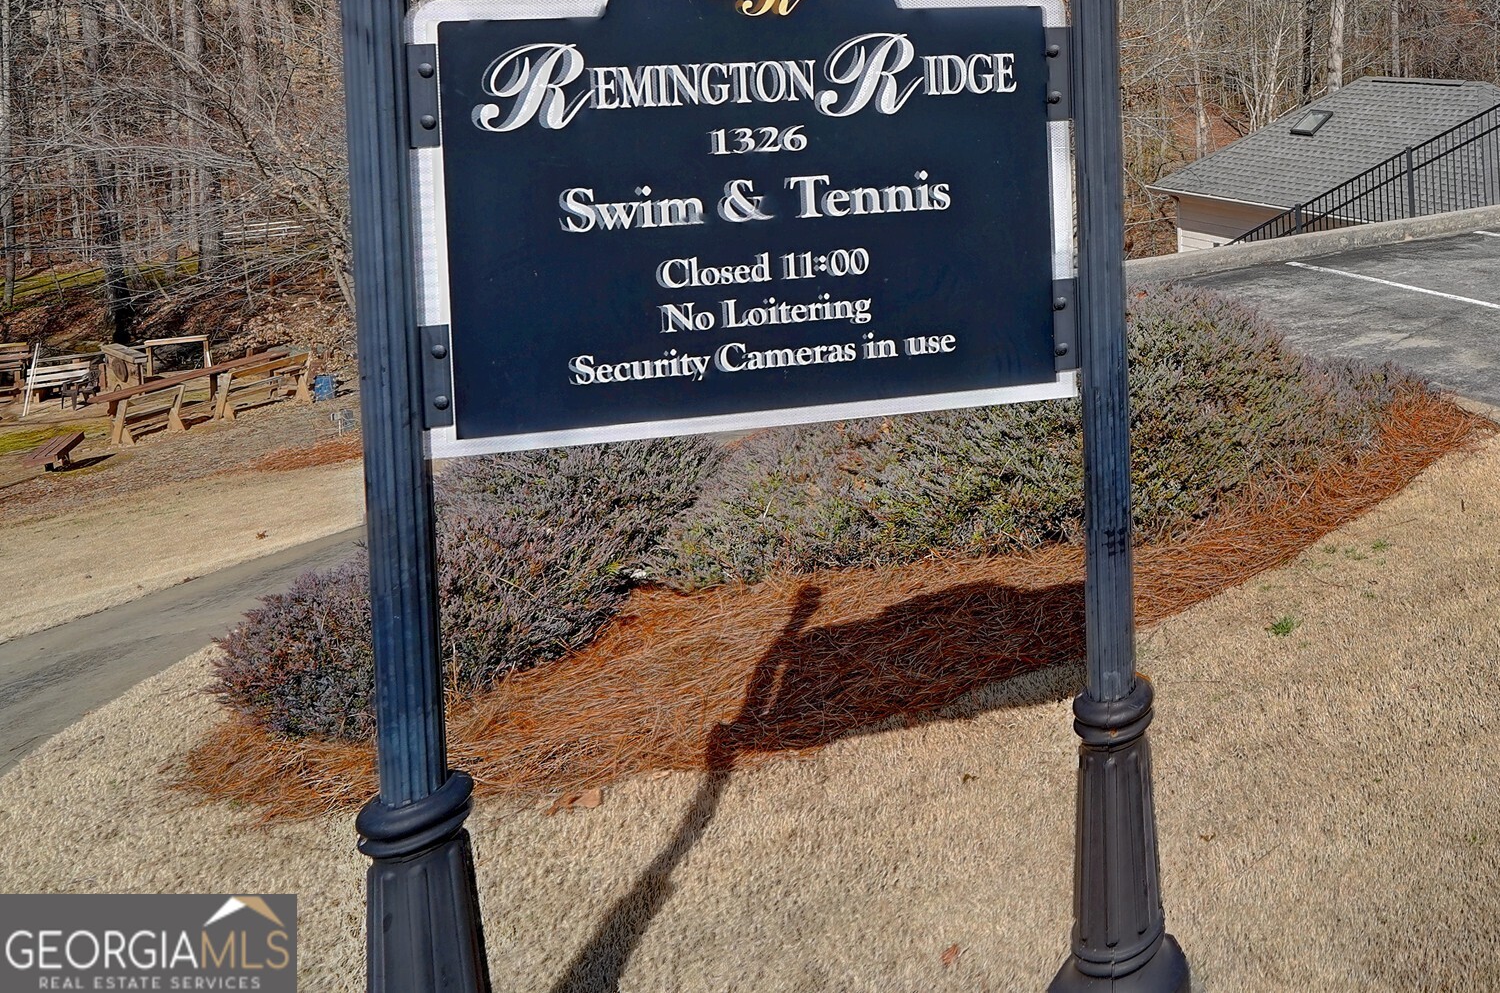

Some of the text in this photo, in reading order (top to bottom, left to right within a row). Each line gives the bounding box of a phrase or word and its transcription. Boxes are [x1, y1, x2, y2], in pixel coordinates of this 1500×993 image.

[474, 32, 1018, 132] REMINGTON RIDGE
[708, 125, 808, 155] 1326
[560, 170, 951, 232] Swim & Tennis
[657, 247, 870, 289] Closed 11:00
[660, 292, 872, 334] No Loitering
[569, 332, 957, 386] Security Cameras in use
